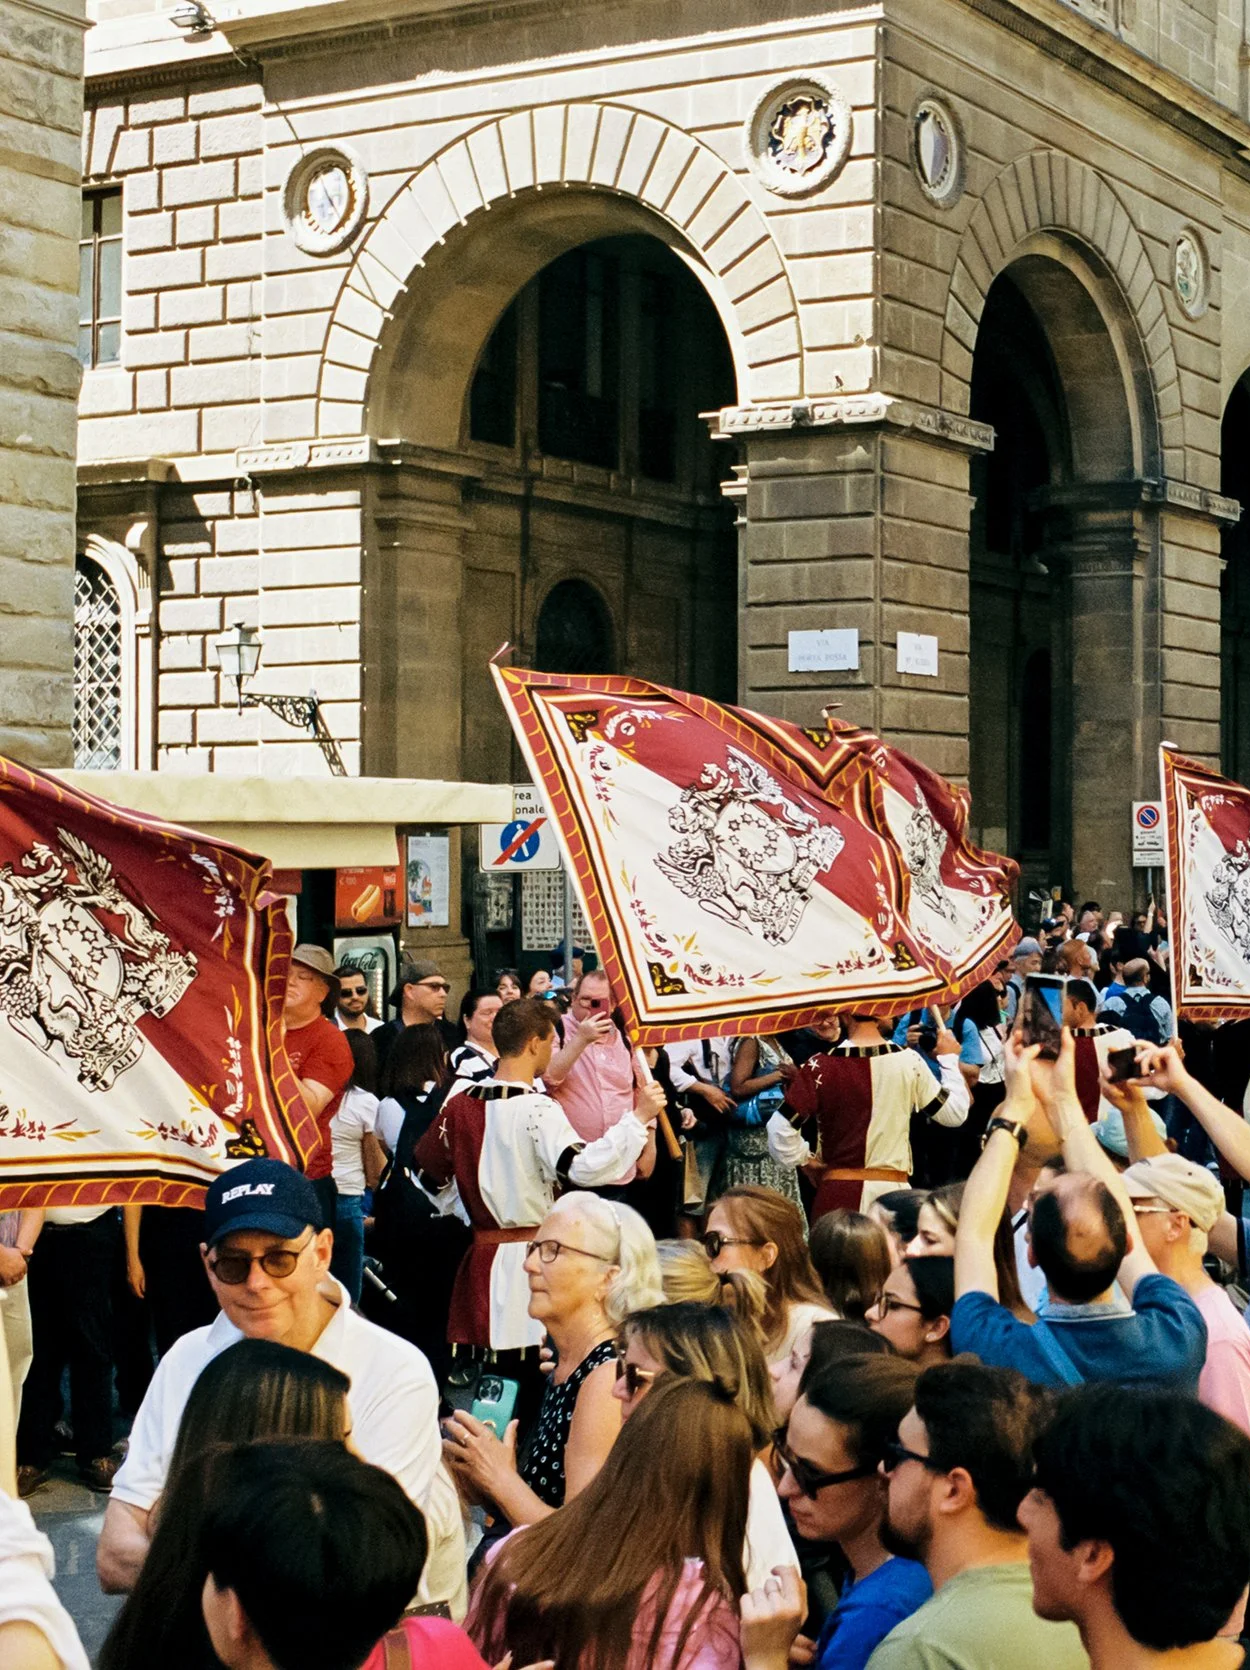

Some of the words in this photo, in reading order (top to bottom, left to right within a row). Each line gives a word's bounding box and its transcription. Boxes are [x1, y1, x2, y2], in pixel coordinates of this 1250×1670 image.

[514, 792, 532, 800] rea
[515, 804, 545, 815] onale
[112, 1048, 138, 1075] ALII
[221, 1183, 275, 1205] REPLAY
